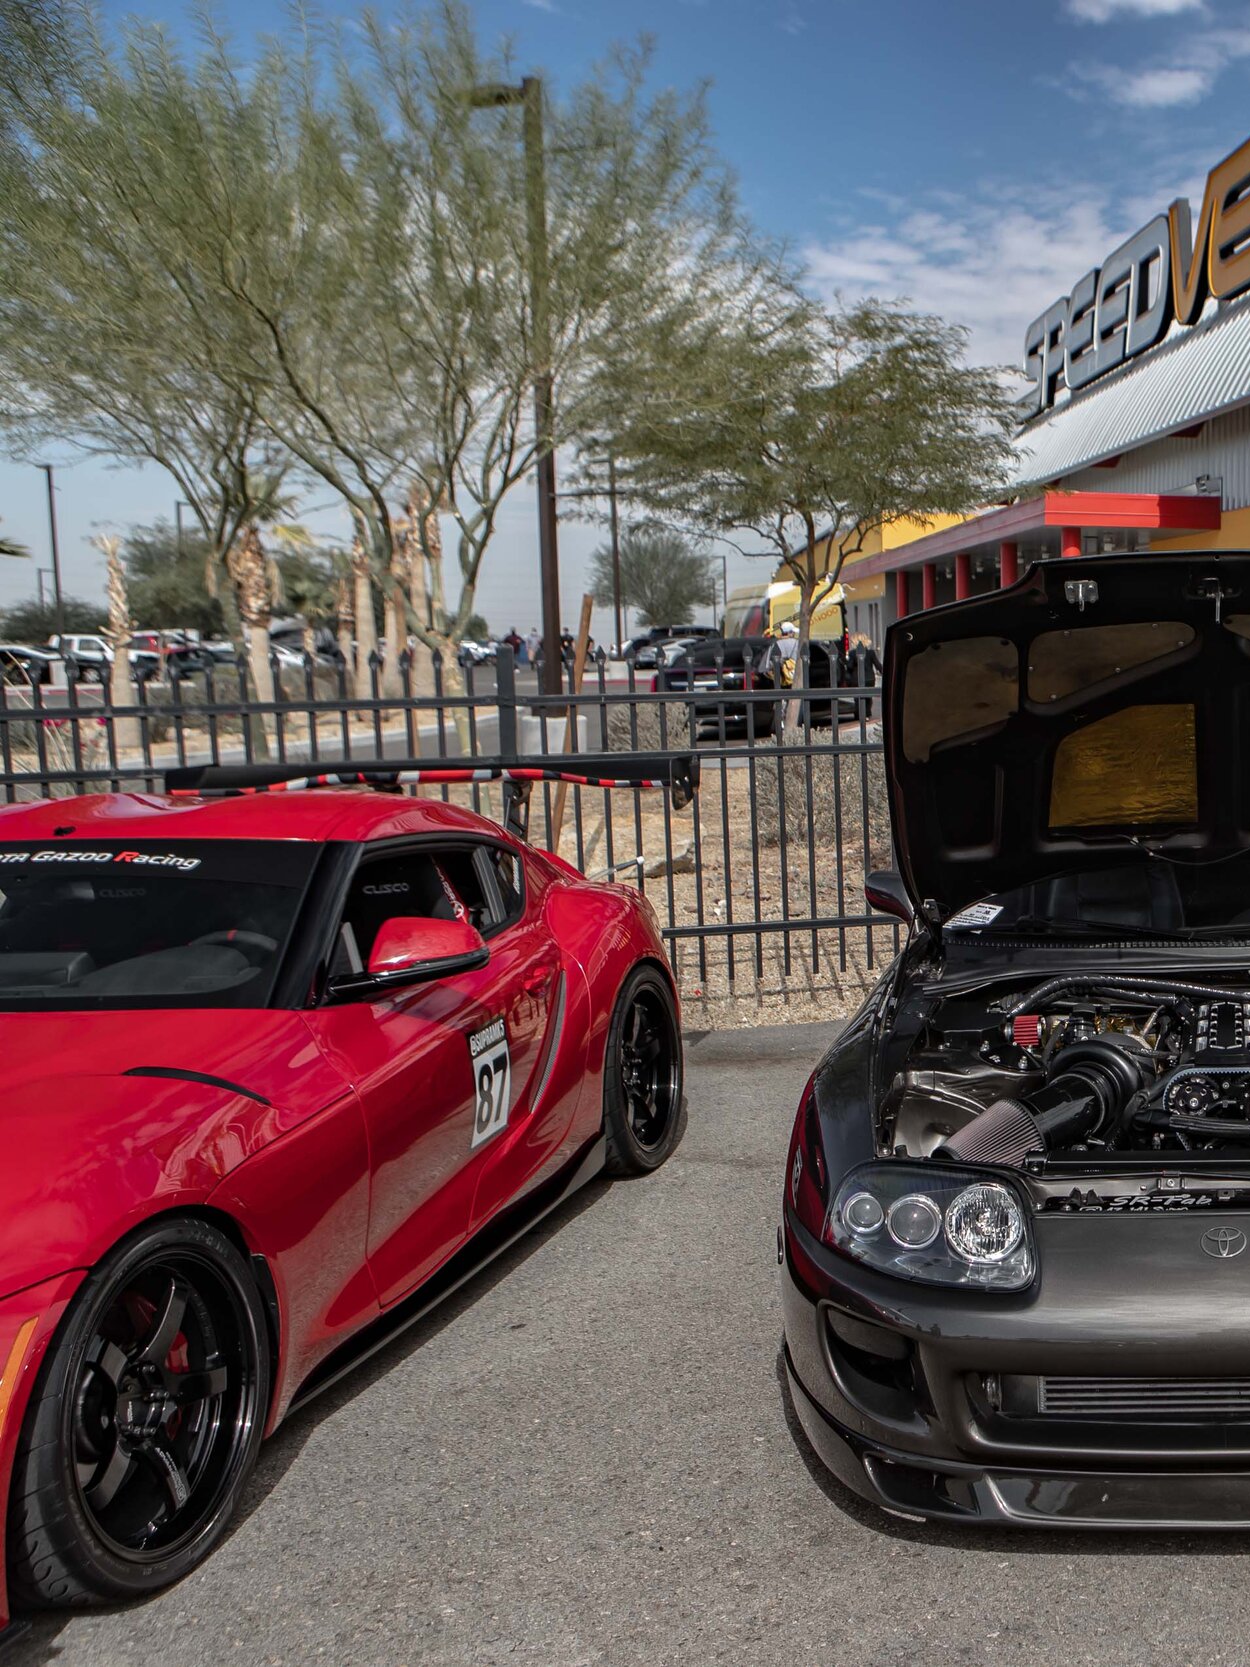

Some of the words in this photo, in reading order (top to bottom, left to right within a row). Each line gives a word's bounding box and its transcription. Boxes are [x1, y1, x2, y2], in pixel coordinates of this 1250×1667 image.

[0, 852, 30, 863] TA
[31, 851, 114, 863] GAZOO
[113, 851, 202, 871] Racing
[363, 883, 410, 895] CUSCO
[476, 1051, 508, 1135] 87
